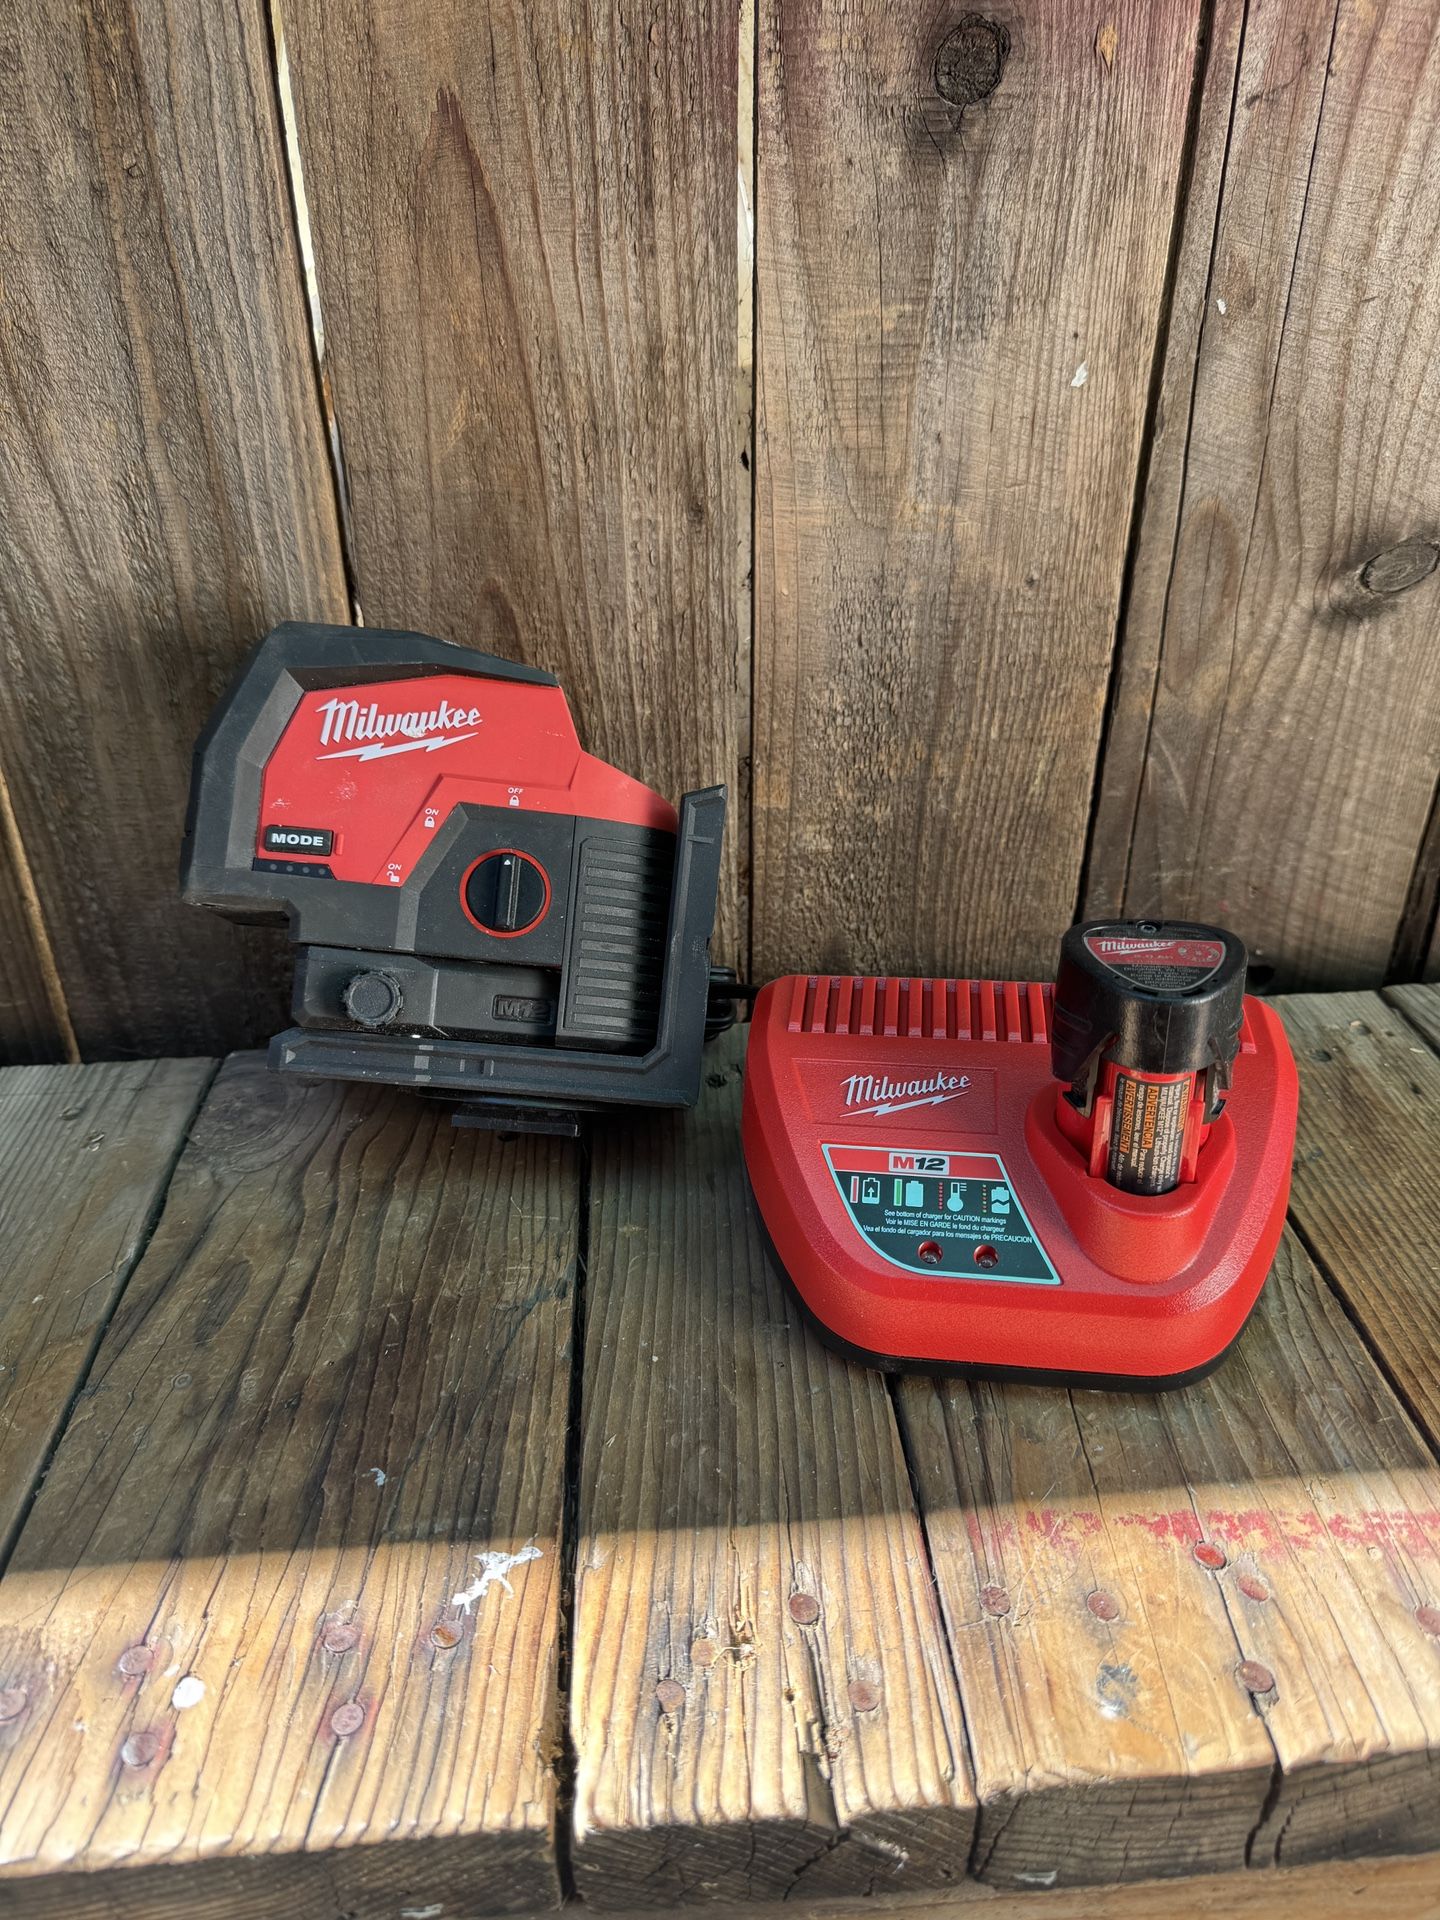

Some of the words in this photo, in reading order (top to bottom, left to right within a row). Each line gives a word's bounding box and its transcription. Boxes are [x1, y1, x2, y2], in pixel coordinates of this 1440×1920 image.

[315, 697, 483, 746] Milwaukee
[425, 807, 439, 816] ON
[271, 833, 324, 847] MODE
[388, 863, 402, 871] ON
[1096, 938, 1176, 952] Milwaukee
[840, 1072, 971, 1106] Milwaukee
[1120, 1083, 1136, 1151] AVERTISSEMENT
[1143, 1088, 1158, 1145] ADVERTENCIA
[893, 1156, 946, 1171] M12
[953, 1214, 980, 1222] CAUTION
[981, 1216, 1006, 1225] markings
[930, 1221, 951, 1229] GARDE
[980, 1225, 1005, 1233] chargeur
[907, 1228, 931, 1236] cargador
[955, 1232, 981, 1240] mensajes
[991, 1234, 1033, 1243] PRECAUCION
